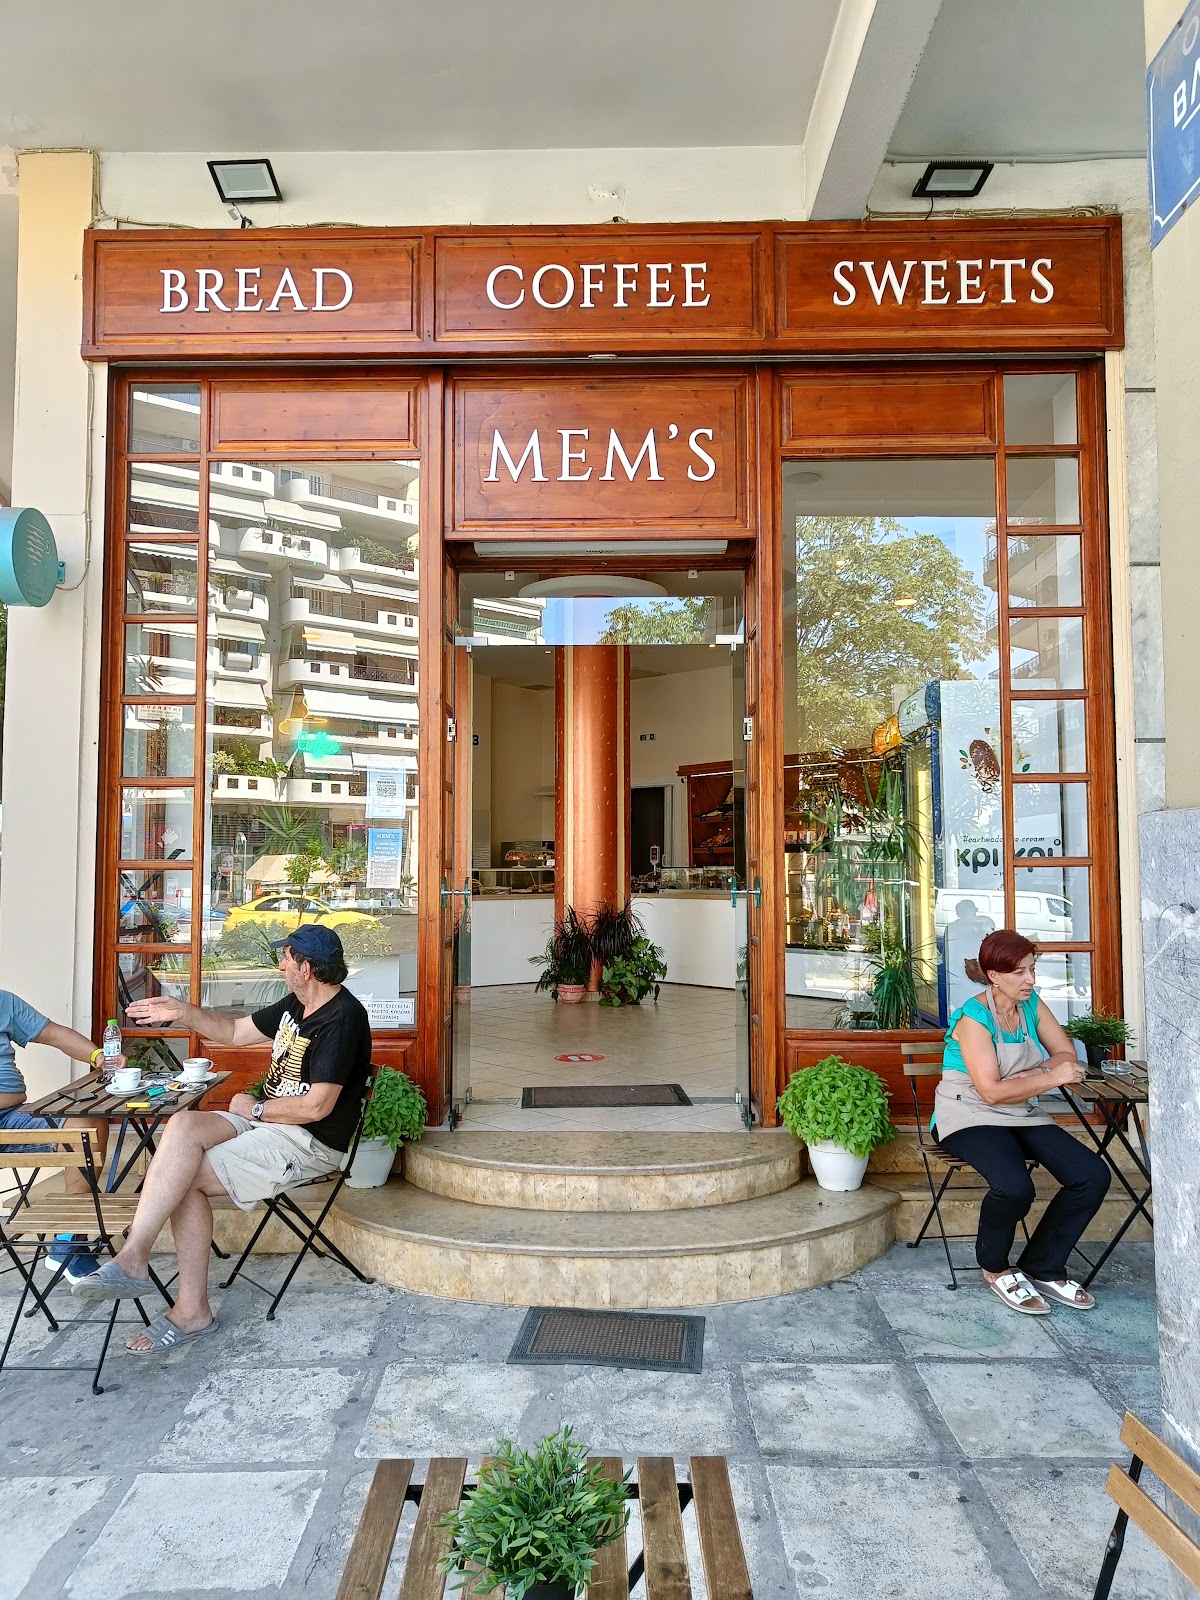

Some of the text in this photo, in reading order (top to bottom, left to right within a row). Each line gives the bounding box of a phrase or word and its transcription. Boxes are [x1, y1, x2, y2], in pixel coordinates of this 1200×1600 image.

[159, 267, 353, 315] BREAD
[486, 262, 711, 310] COFFEE
[833, 258, 1054, 306] SWEETS
[297, 730, 340, 759] Coffee
